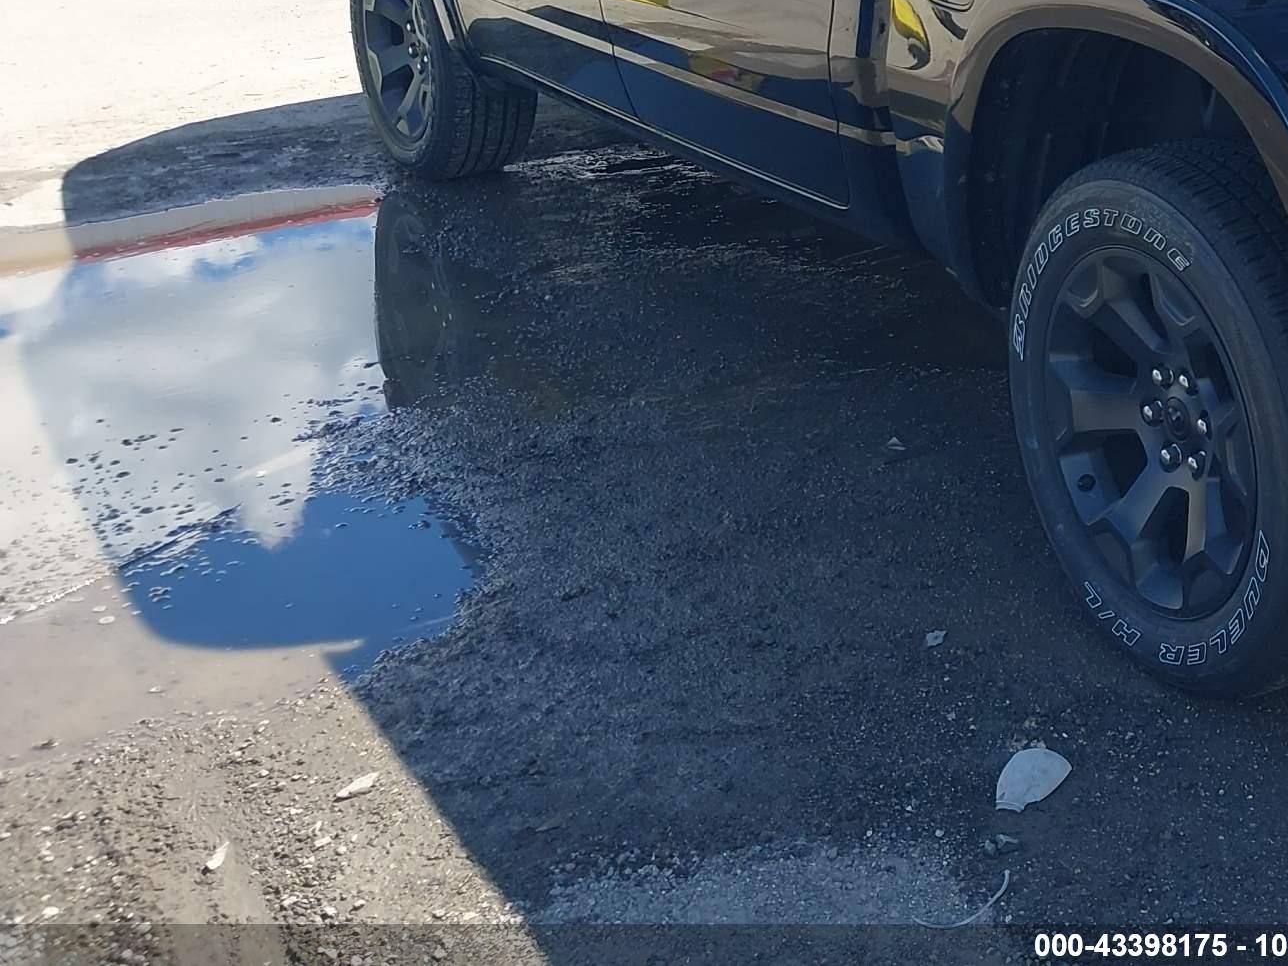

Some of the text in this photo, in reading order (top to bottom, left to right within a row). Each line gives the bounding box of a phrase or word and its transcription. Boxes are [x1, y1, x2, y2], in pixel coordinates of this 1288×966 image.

[1013, 208, 1191, 361] BRIDGESTONE
[1084, 530, 1270, 666] DUELER H/L
